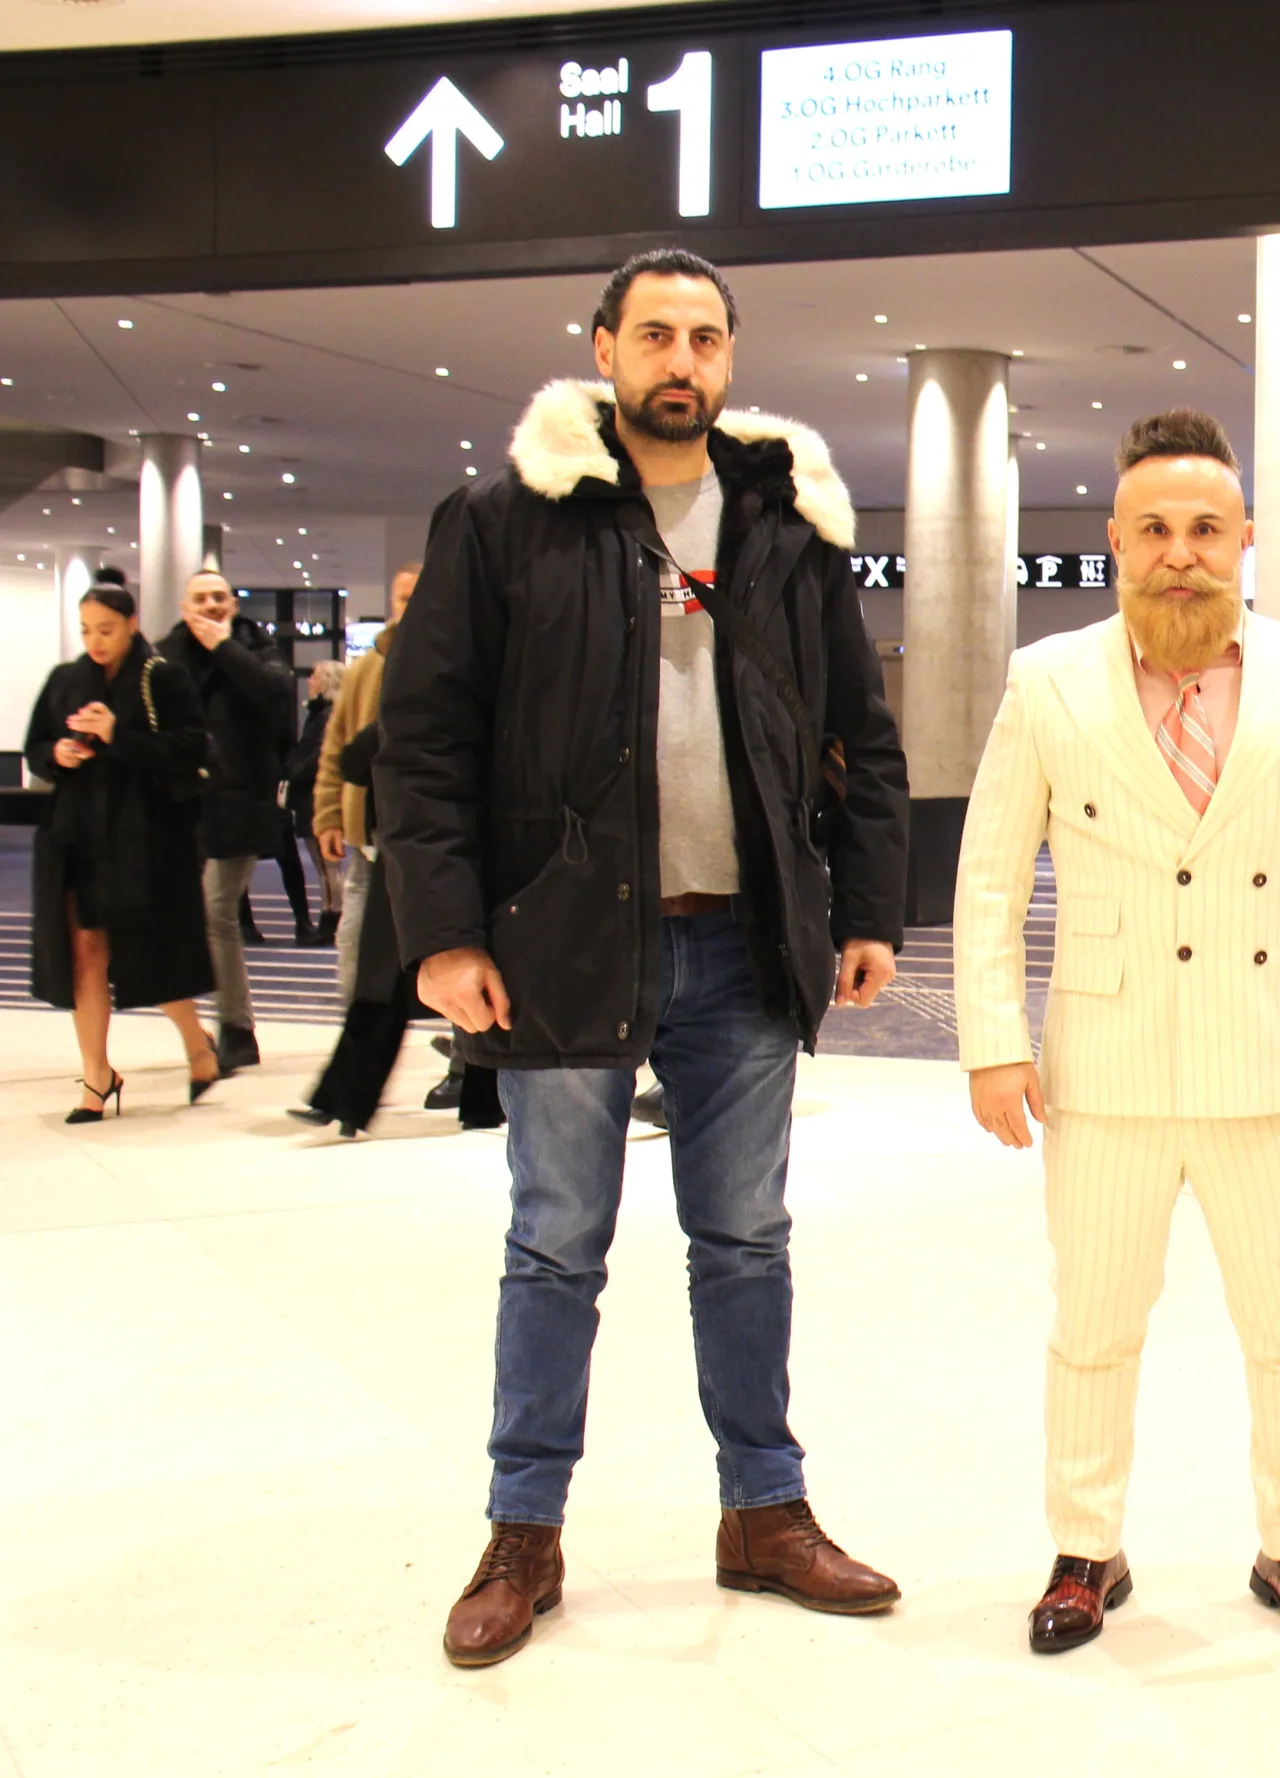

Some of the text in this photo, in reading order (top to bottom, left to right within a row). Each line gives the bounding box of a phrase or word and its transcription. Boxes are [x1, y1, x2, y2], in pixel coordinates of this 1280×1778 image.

[559, 57, 629, 98] Saal
[822, 58, 946, 82] 4.OG Rang
[780, 87, 990, 119] 3.OG Hochparkett
[559, 100, 622, 139] Hall
[647, 50, 711, 217] 1
[810, 123, 957, 149] 2.OG Parkett
[793, 153, 976, 182] 1OG Garderobe
[863, 556, 889, 587] X
[1041, 561, 1058, 582] P
